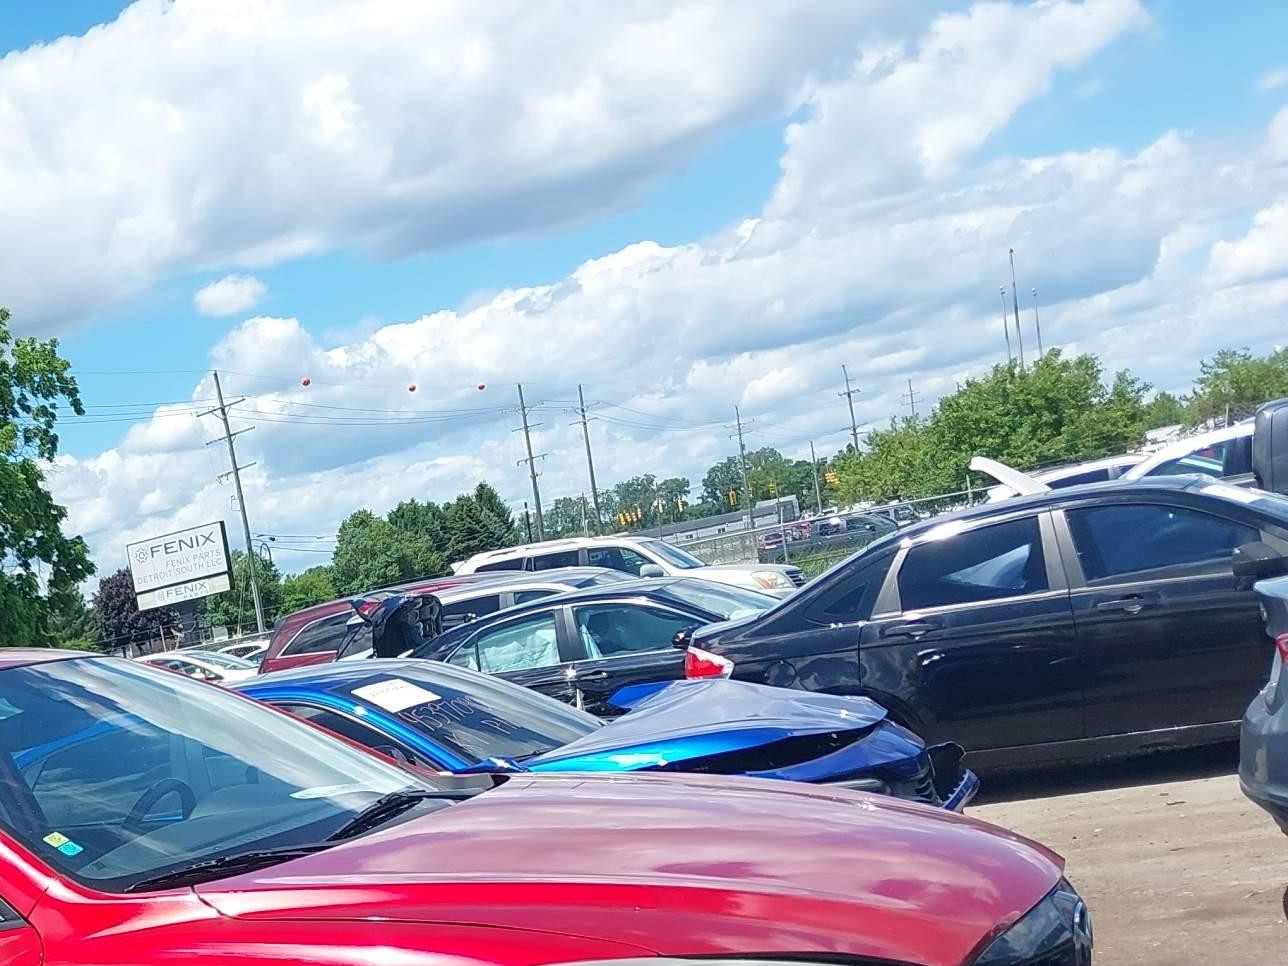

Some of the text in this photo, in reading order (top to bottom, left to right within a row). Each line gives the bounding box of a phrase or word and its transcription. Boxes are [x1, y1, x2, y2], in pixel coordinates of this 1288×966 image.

[150, 531, 216, 558] FENIX
[166, 549, 221, 568] FENIX PARTS
[137, 557, 222, 585] DETROIT SOUTH LLC
[166, 581, 207, 598] FENIX
